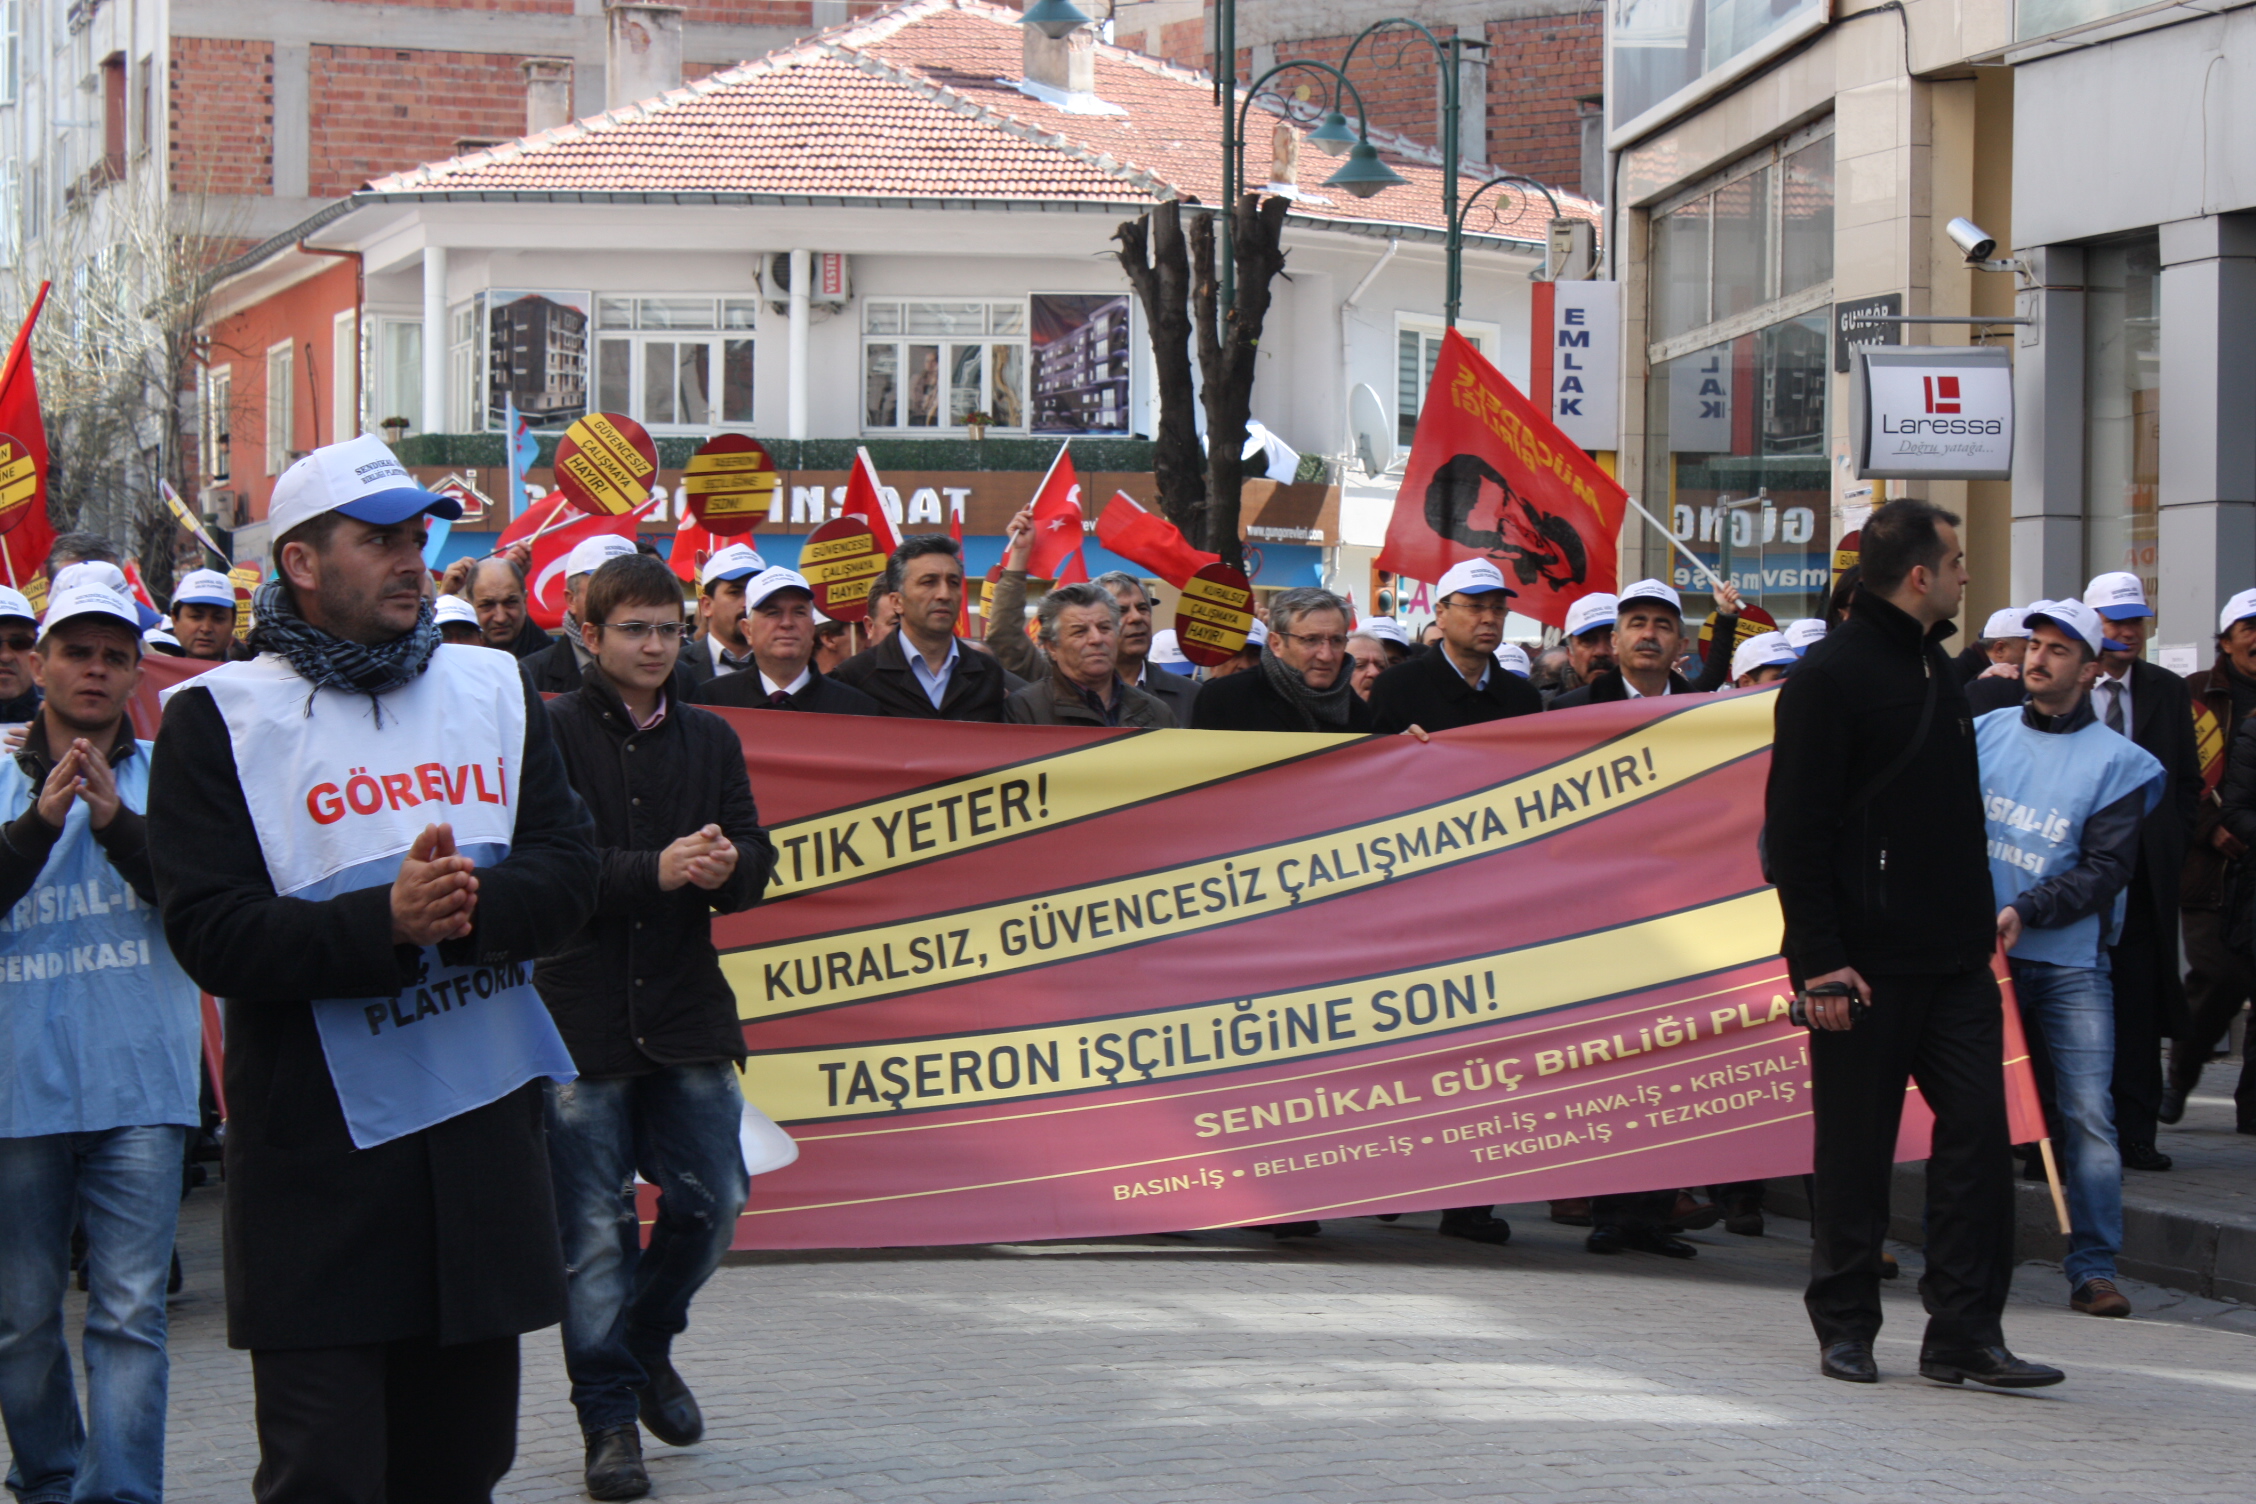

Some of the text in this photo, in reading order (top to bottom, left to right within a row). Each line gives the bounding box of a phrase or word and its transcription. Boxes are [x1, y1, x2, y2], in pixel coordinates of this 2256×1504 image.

[1558, 308, 1590, 416] EMLAK
[1883, 414, 2001, 435] Laressa
[355, 459, 395, 475] SENDİKAL
[580, 440, 632, 488] ÇALIŞMAYA
[594, 421, 648, 474] GÜVENCESİZ
[1899, 439, 1938, 456] Doğru
[569, 457, 609, 494] HAYIR!
[812, 536, 871, 558] GÜVENCESİZ
[822, 560, 875, 581] ÇALIŞMAYA
[830, 581, 868, 601] HAYIR!
[1191, 603, 1239, 624] ÇALIŞMAYA
[1204, 585, 1246, 604] KURALSIZ
[1188, 624, 1225, 643] HAYIR!
[306, 757, 508, 826] GÖREVLİ
[872, 772, 1049, 859] YETER!
[763, 746, 1659, 1002] KURALSIZ, GÜVENCESİZ ÇALIŞMAYA HAYIR!
[818, 1040, 1060, 1110] TAŞERON
[1371, 970, 1499, 1032] SON!
[1194, 1081, 1422, 1138] SENDİKAL
[1431, 1057, 1524, 1097] GÜÇ
[1535, 1015, 1699, 1077] BİRLİĞİ
[1113, 1168, 1225, 1201] BASIN-İŞ
[1254, 1135, 1414, 1178] BELEDİYE-İŞ
[1442, 1111, 1537, 1144] DERİ-İŞ
[1565, 1085, 1663, 1119] HAVA-İŞ
[1470, 1081, 1796, 1163] TEKGIDA-İŞ TEZKOOP-İŞ
